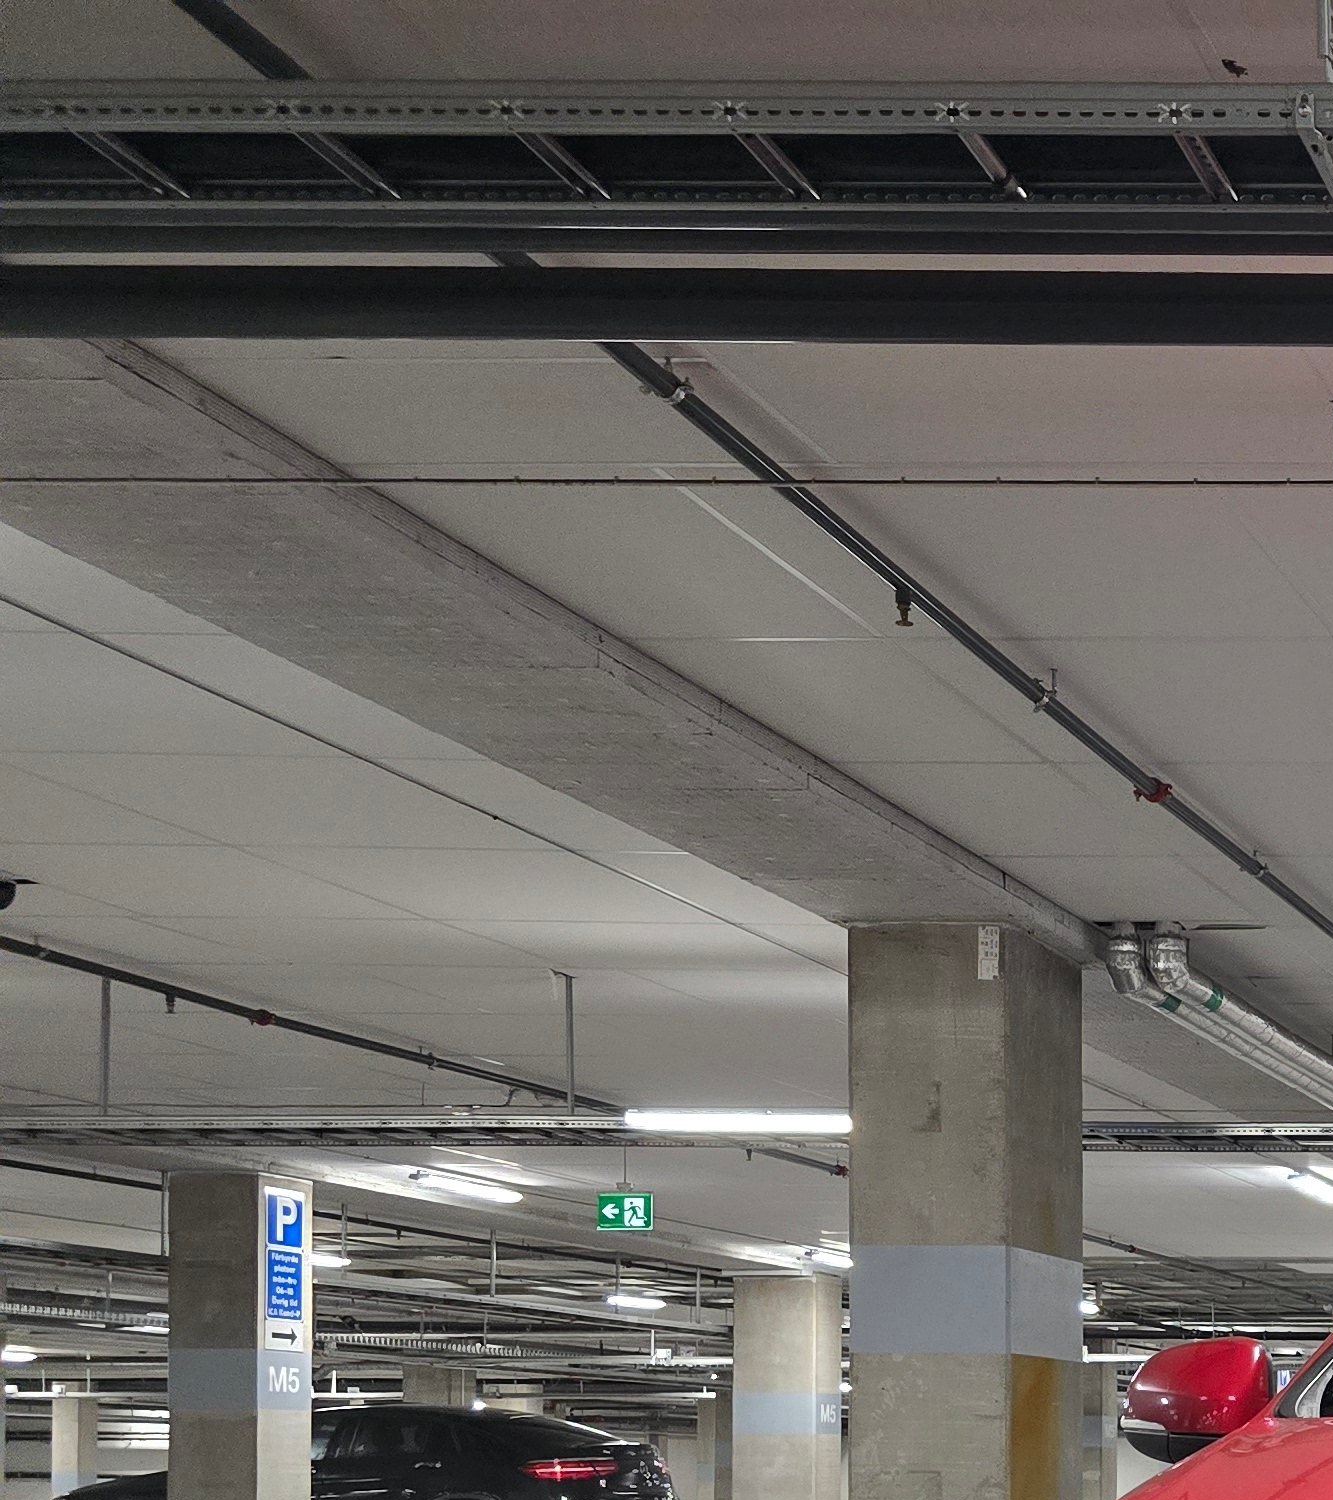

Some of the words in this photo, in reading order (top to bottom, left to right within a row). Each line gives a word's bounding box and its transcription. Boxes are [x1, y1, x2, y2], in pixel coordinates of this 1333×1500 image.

[276, 1195, 298, 1242] P
[269, 1366, 300, 1393] M5
[820, 1404, 836, 1423] M5
